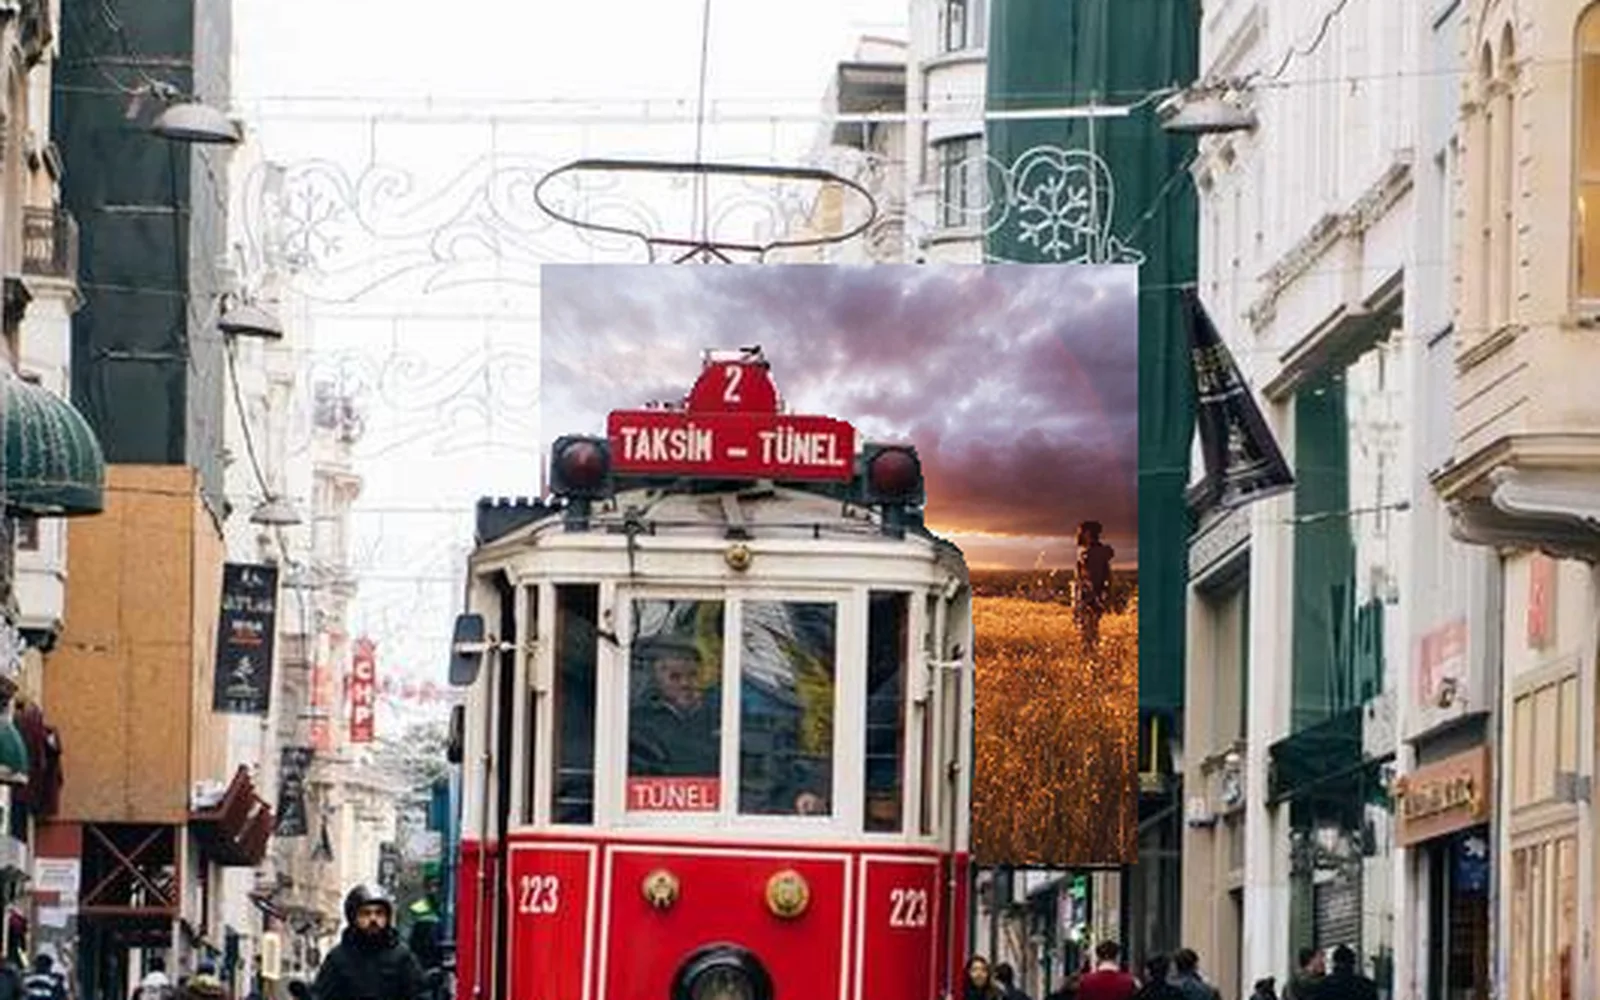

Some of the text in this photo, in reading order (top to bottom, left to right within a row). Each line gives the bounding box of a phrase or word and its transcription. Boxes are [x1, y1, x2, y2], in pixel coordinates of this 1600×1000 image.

[723, 365, 743, 402] 2
[620, 422, 713, 461] TAKSİM
[758, 425, 847, 466] TÜNEL
[355, 661, 373, 726] CHP
[518, 875, 559, 914] 223
[890, 888, 928, 928] 223
